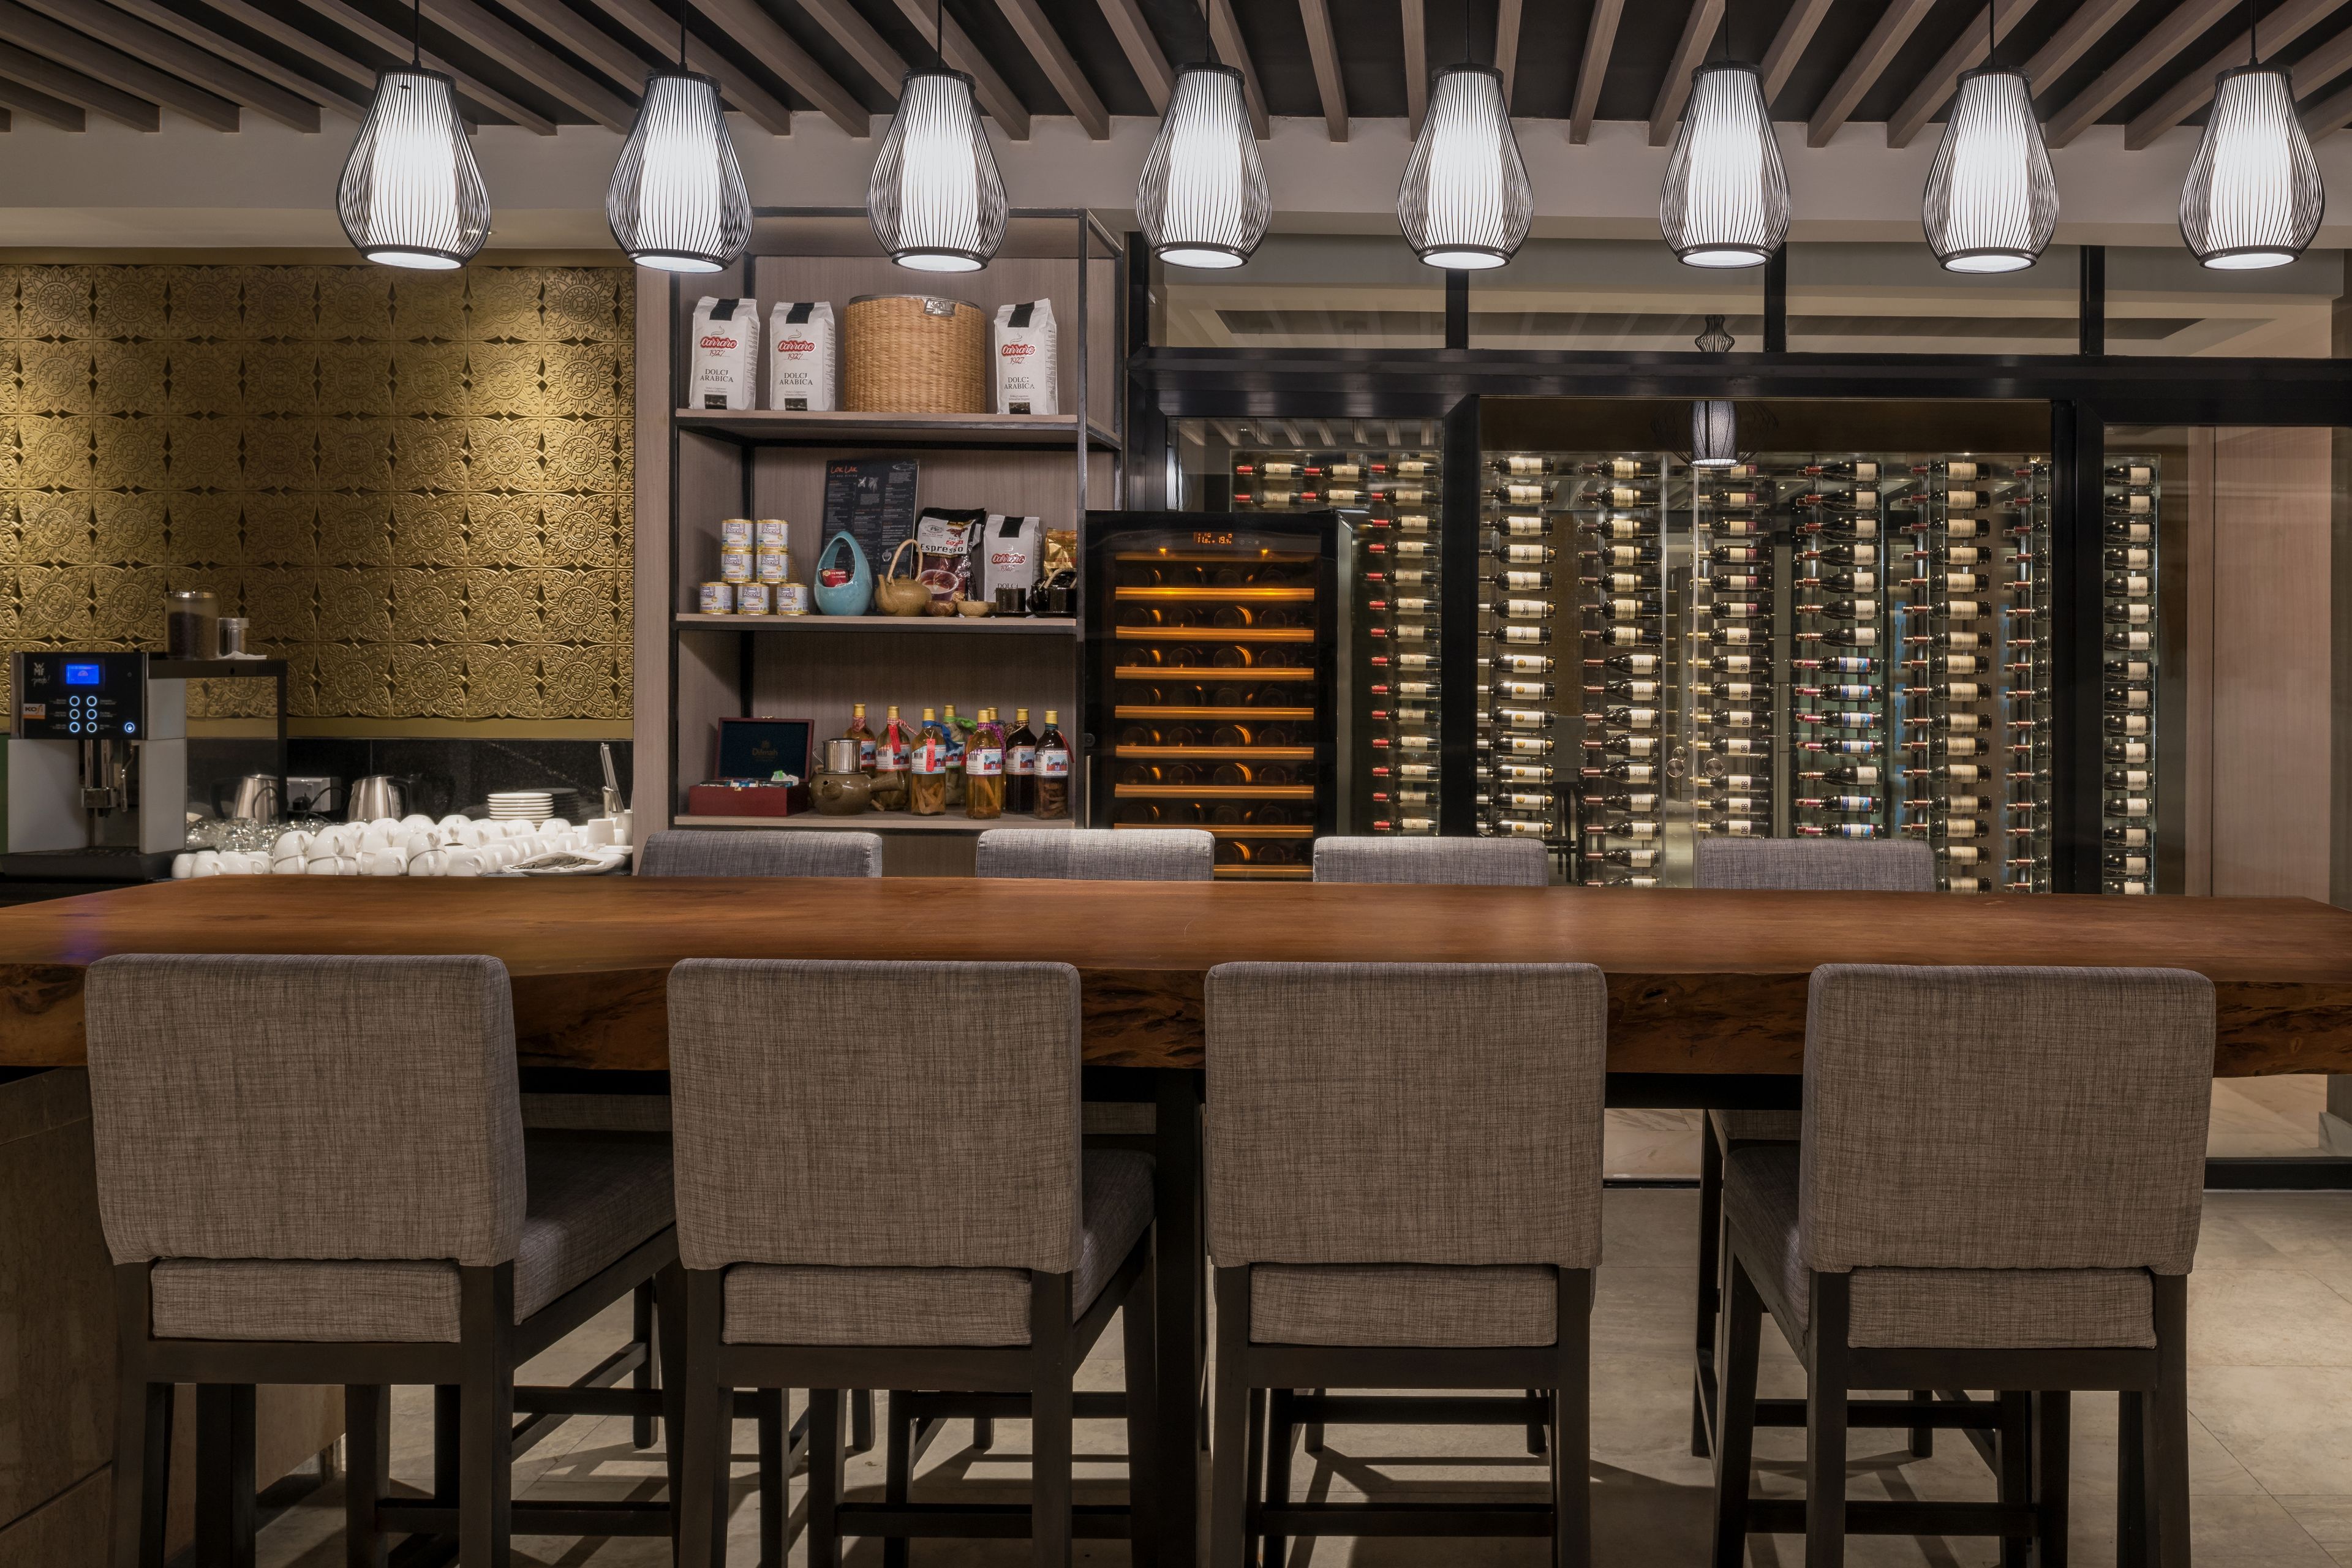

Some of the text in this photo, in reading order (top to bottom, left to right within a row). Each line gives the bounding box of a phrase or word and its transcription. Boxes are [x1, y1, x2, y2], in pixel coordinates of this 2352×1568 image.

[701, 337, 737, 348] Carraro
[778, 341, 815, 352] Carraro
[921, 543, 963, 553] Espresso
